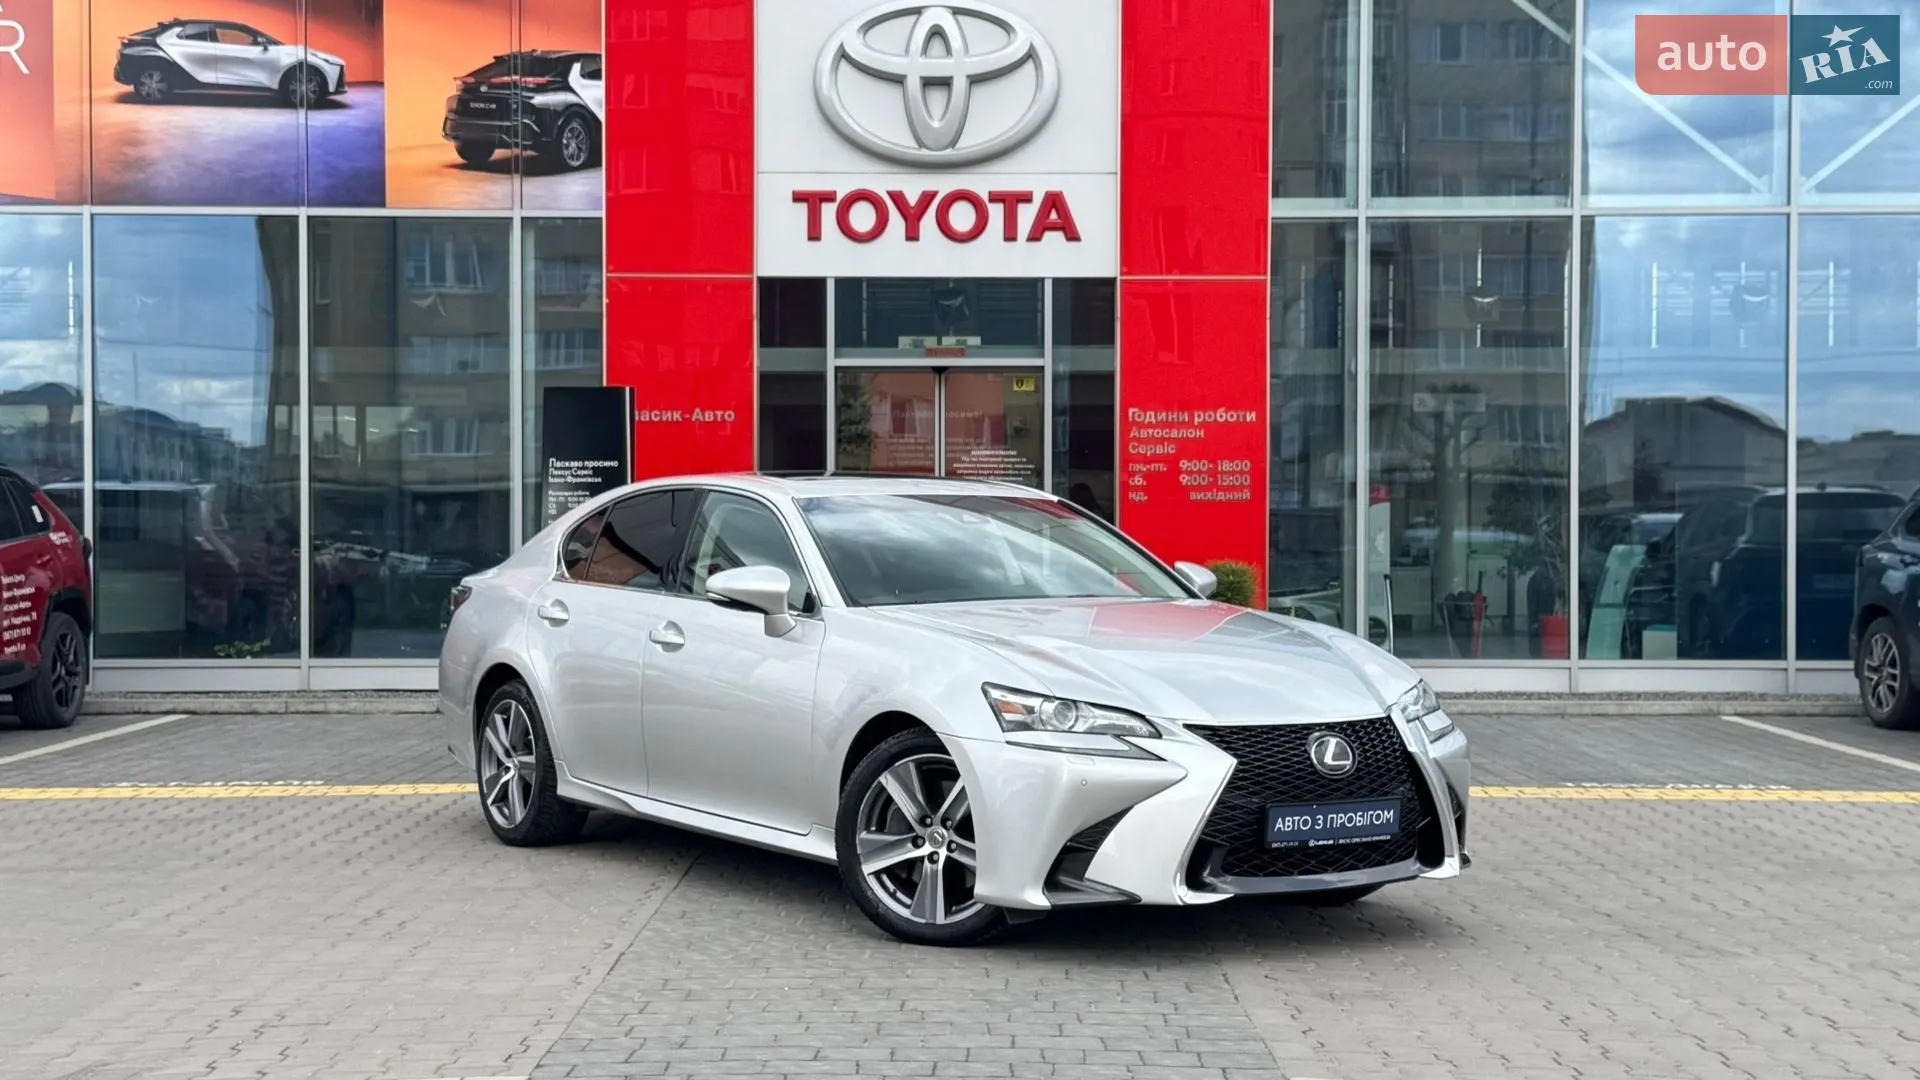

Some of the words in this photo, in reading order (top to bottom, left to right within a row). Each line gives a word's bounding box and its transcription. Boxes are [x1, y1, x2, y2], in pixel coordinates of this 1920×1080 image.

[792, 188, 1082, 243] TOYOTA
[1128, 407, 1189, 424] Години
[1194, 407, 1256, 426] роботи
[1129, 426, 1205, 439] Автосалон
[1128, 441, 1176, 457] Сервіс
[584, 460, 619, 468] просимо
[1189, 488, 1251, 502] вихідний
[1274, 815, 1312, 832] АВТО
[1326, 809, 1394, 829] ПРОБІГОМ
